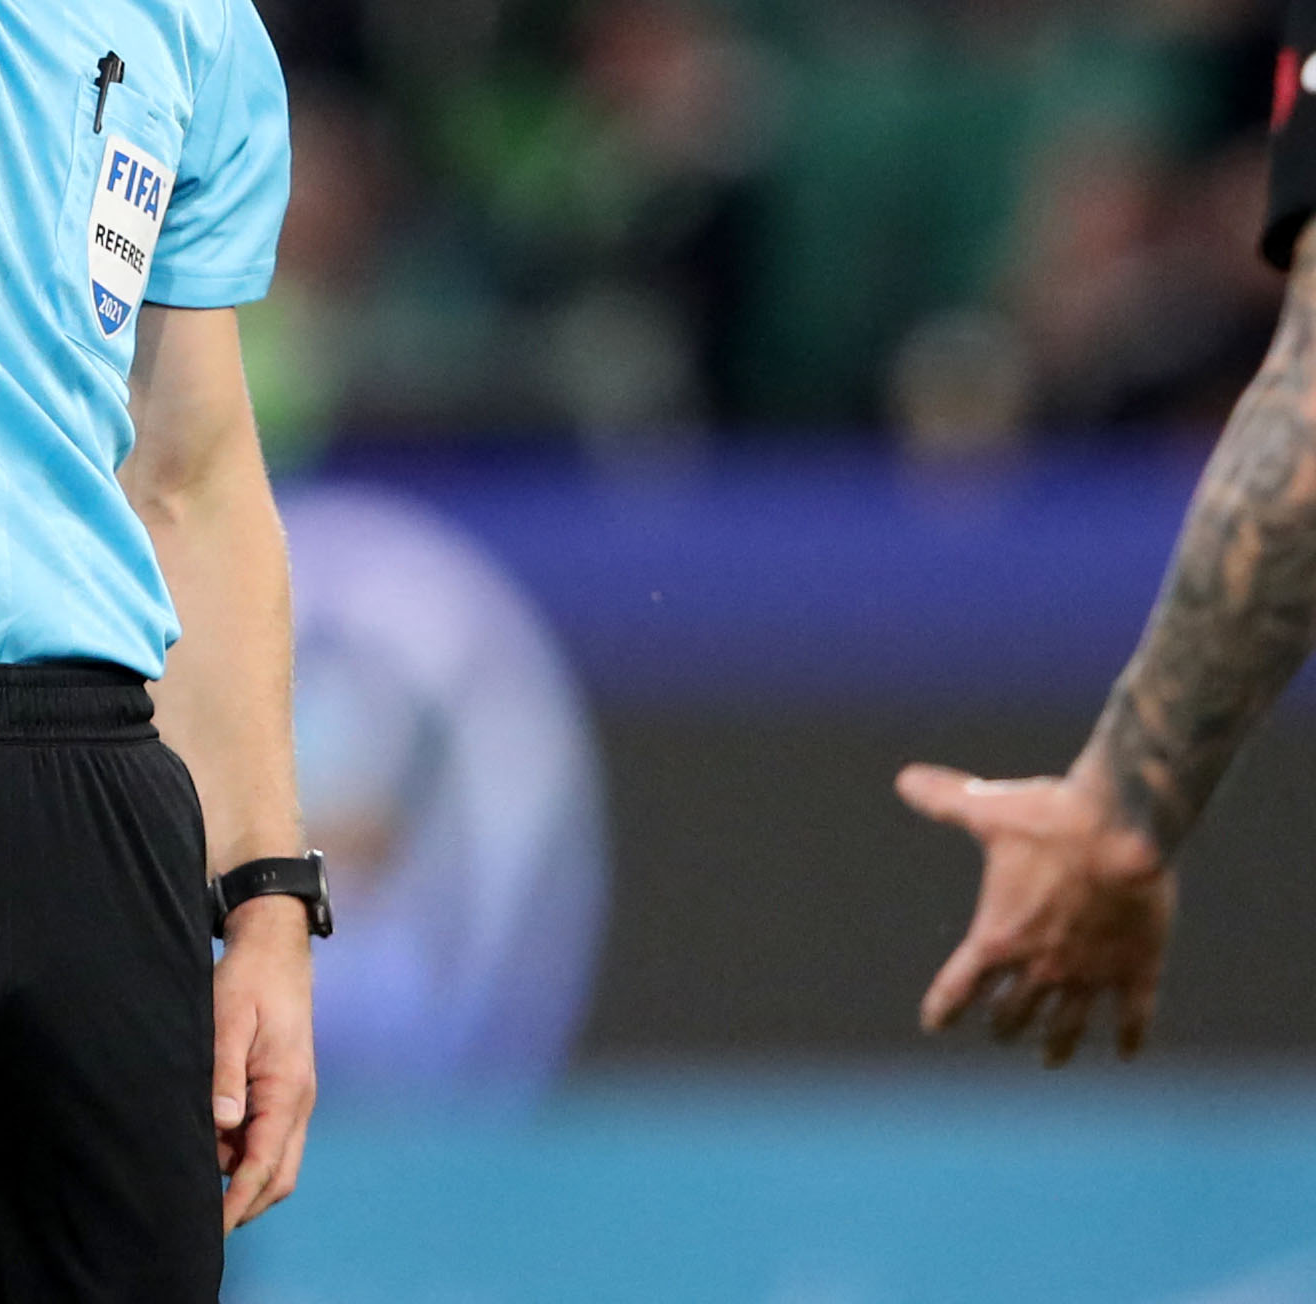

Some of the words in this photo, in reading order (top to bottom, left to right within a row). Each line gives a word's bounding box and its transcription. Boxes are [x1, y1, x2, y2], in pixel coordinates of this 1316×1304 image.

[106, 150, 162, 221] FIFA
[95, 223, 146, 275] REFEREE
[98, 293, 123, 324] 2021
